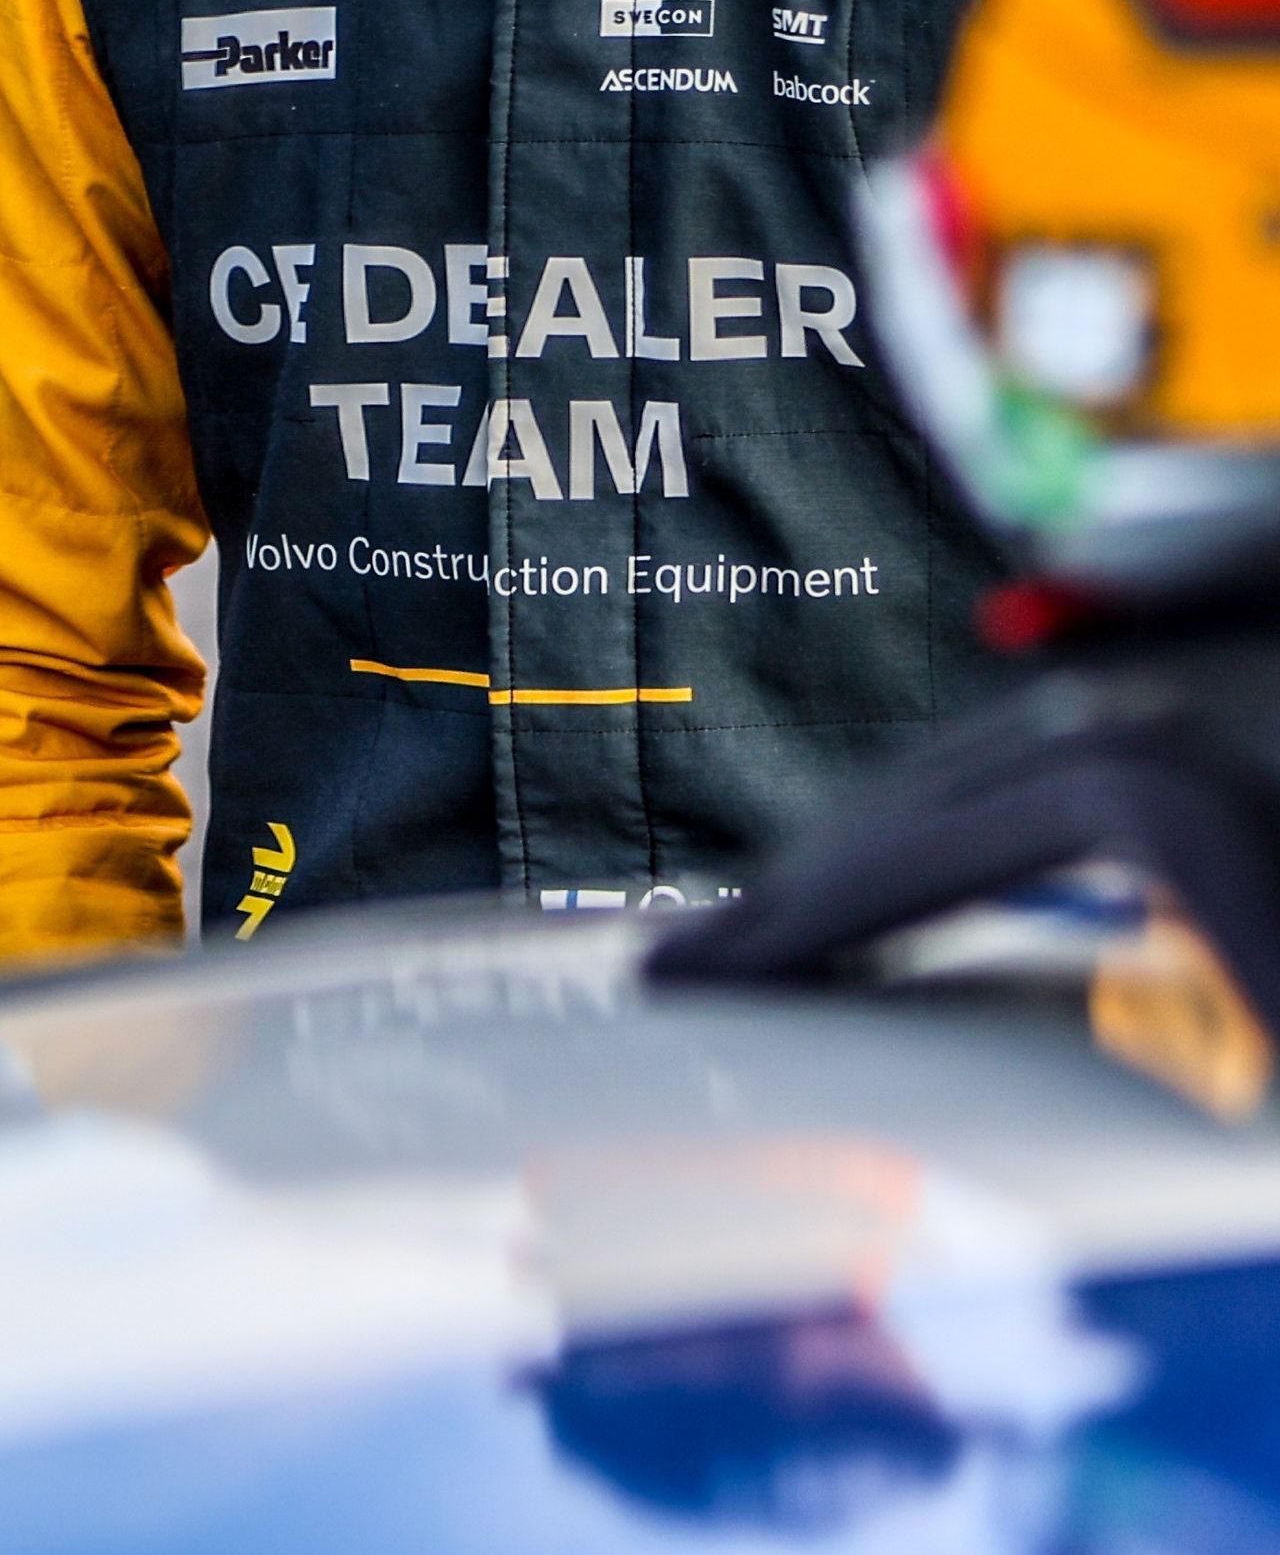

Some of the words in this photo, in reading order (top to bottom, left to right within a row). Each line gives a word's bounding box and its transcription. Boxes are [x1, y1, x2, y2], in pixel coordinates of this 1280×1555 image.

[613, 9, 703, 25] SVECON
[772, 7, 828, 37] SMT
[215, 30, 334, 77] Parker
[599, 68, 739, 94] ASCENDUM
[773, 70, 871, 106] babcock
[342, 243, 867, 368] DEALER
[308, 382, 691, 502] TEAM
[348, 535, 608, 596] Construction
[627, 552, 880, 604] Equipment
